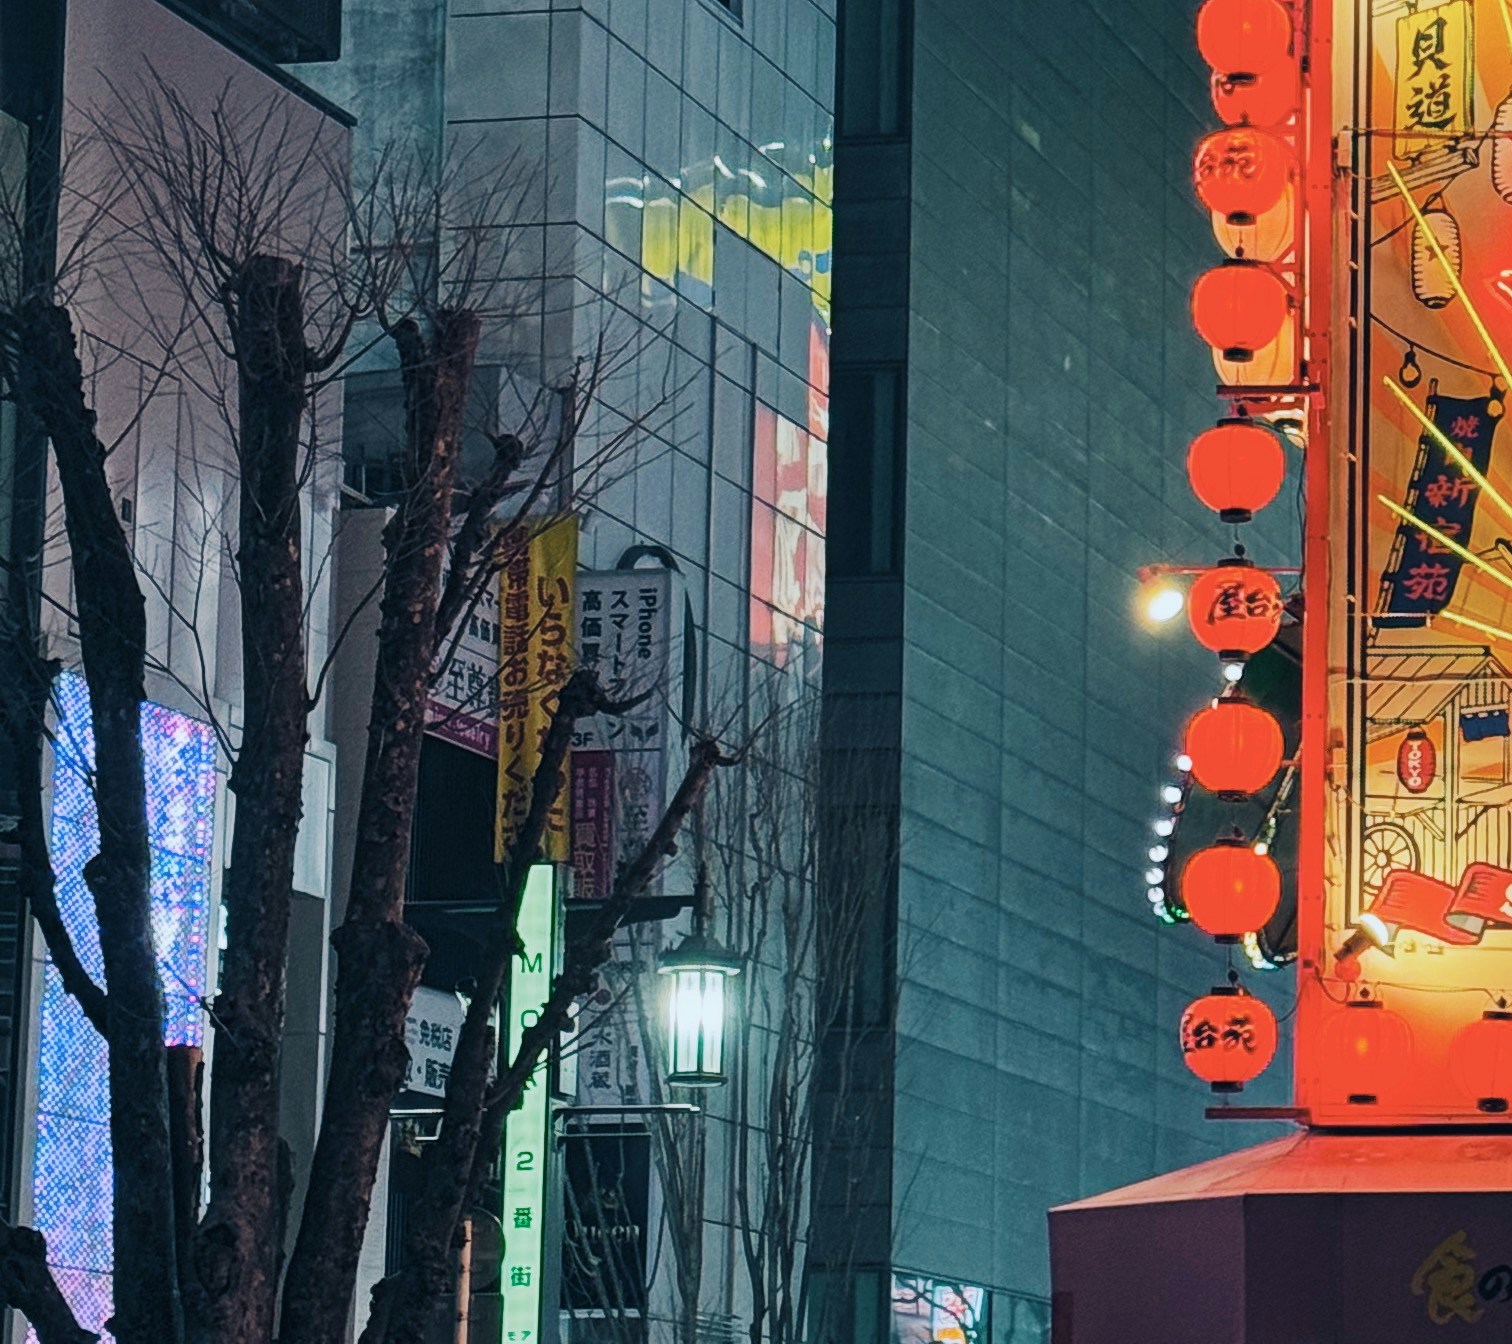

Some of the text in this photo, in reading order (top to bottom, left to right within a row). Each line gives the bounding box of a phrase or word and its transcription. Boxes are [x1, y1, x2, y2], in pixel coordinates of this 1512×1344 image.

[1403, 16, 1458, 130] 貝道
[636, 587, 659, 660] iPhone
[606, 591, 630, 740] スマートフン
[571, 732, 594, 747] 3F
[1408, 742, 1422, 787] TOKYO
